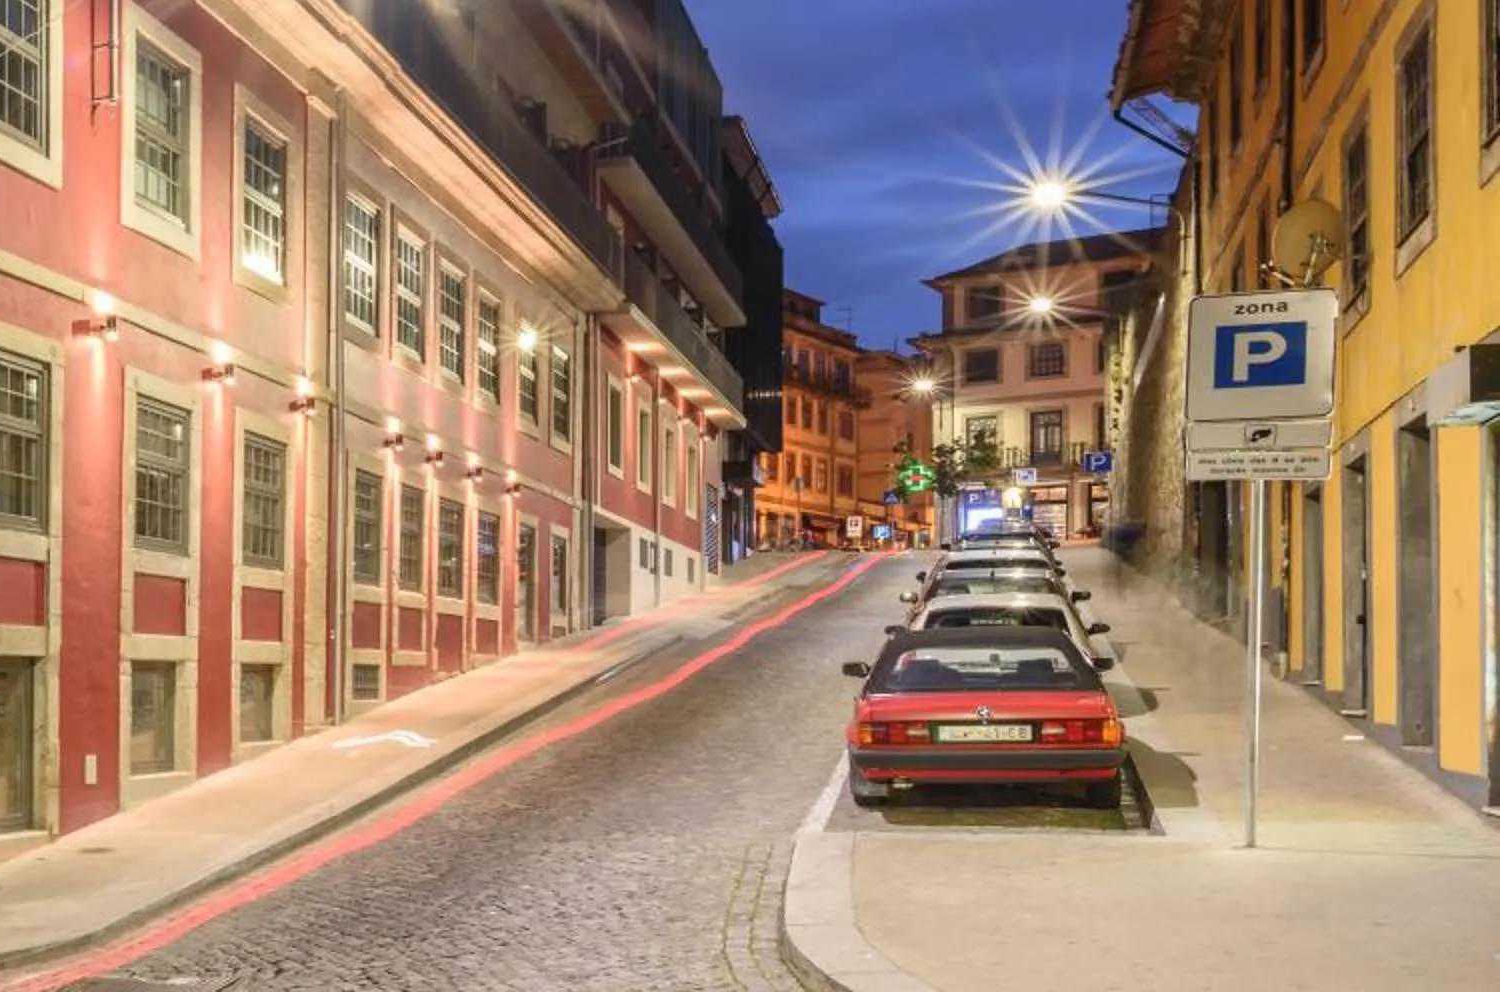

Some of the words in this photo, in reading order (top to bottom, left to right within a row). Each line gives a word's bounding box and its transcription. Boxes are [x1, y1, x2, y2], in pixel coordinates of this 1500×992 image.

[1233, 301, 1289, 315] zona
[1232, 331, 1288, 383] P
[1090, 454, 1107, 471] P
